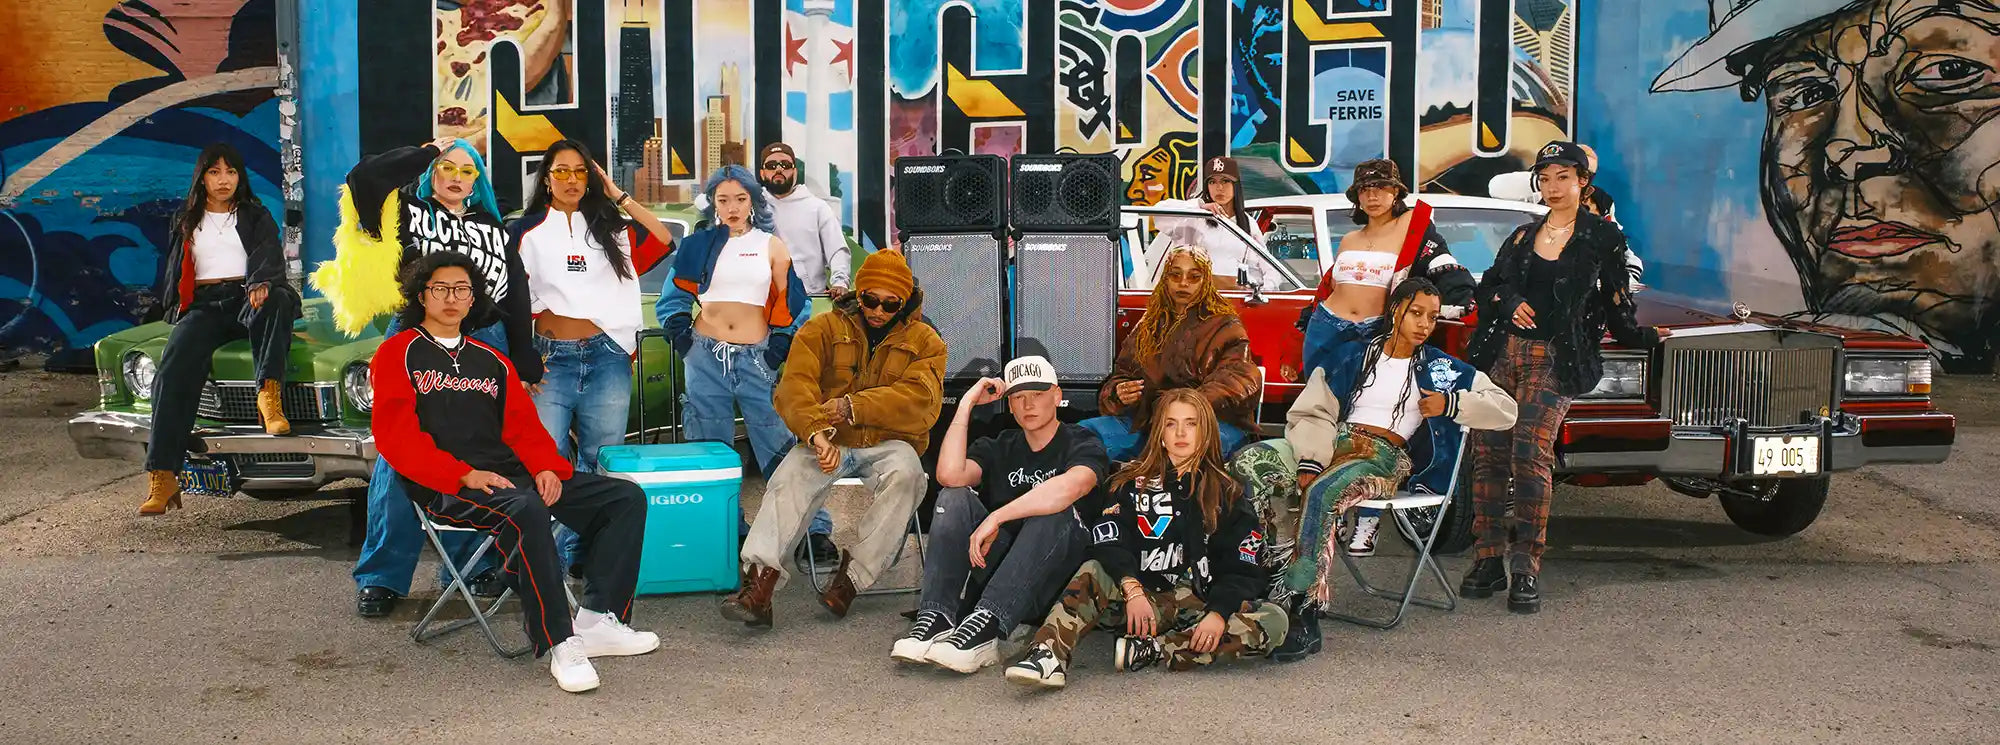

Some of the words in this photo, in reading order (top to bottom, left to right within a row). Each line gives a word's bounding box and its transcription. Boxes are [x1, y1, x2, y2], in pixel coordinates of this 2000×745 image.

[1337, 89, 1375, 102] SAVE
[1329, 105, 1382, 120] FERRIS
[904, 165, 946, 174] SOUNDBOKS
[1020, 164, 1062, 172] SOUNDBOKS
[911, 244, 952, 252] SOUNDBOKS
[1024, 243, 1067, 252] SOUNDBOKS
[567, 254, 587, 266] USA
[1008, 363, 1042, 383] CHICAGO
[1758, 448, 1774, 468] 49
[1781, 447, 1804, 467] 005
[650, 493, 704, 506] IGLOO
